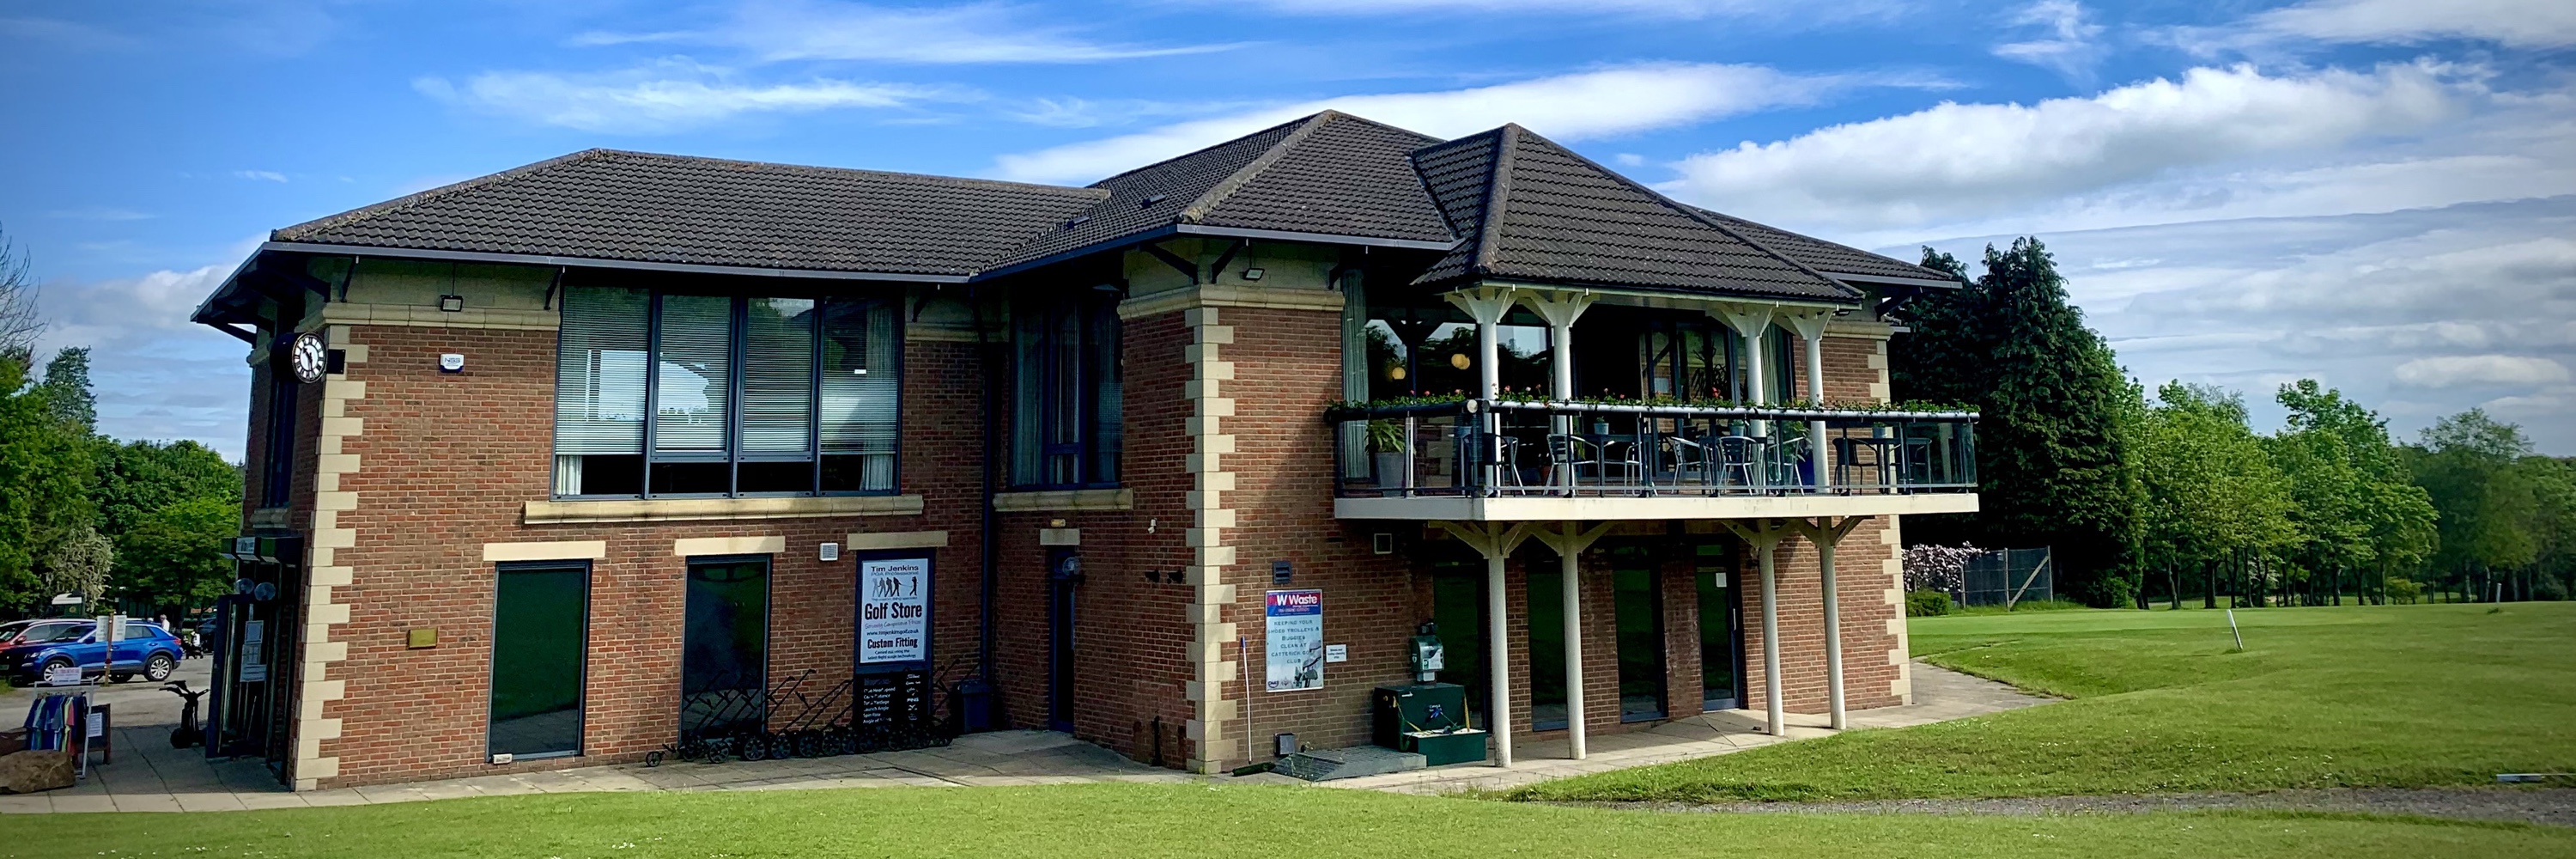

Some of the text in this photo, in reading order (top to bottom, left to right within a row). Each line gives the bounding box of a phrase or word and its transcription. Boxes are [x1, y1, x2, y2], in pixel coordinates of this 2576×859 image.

[1288, 594, 1318, 606] Waste
[865, 601, 922, 620] Golf Store
[867, 637, 918, 649] Custom Fitting
